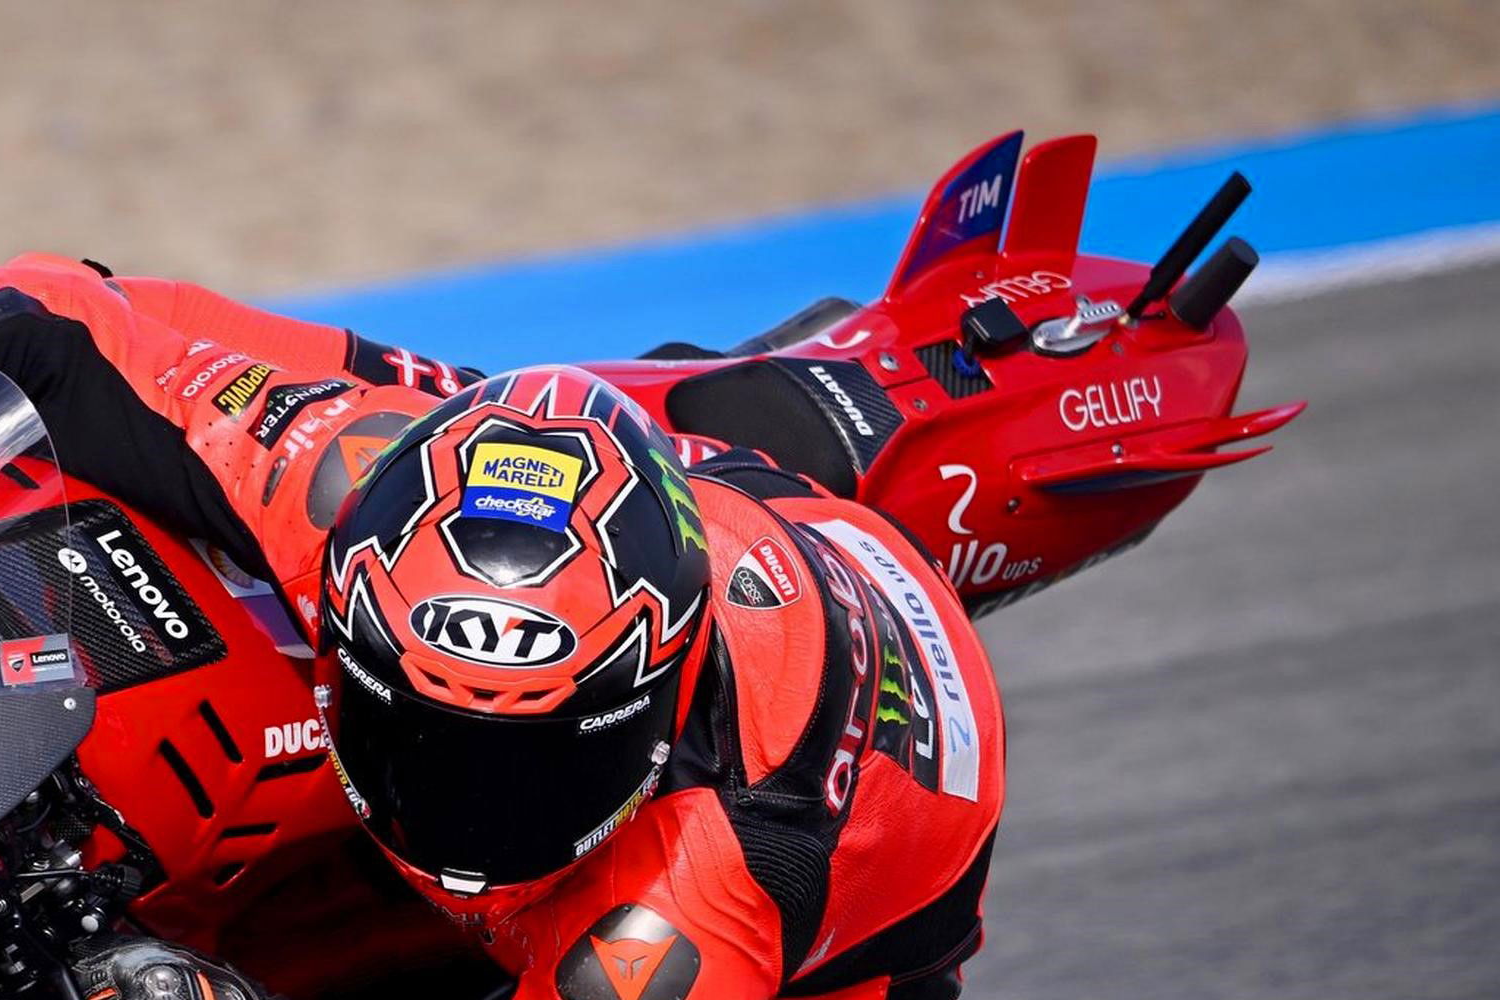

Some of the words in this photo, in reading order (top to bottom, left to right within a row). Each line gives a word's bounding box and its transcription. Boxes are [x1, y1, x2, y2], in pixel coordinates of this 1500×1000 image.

[957, 174, 1002, 224] TIM
[809, 366, 874, 437] DUCATI
[1059, 376, 1162, 432] GELLIFY
[95, 529, 189, 639] Lenovo
[759, 545, 795, 597] DUCATI
[1002, 556, 1043, 582] ups
[79, 575, 147, 653] motorola
[423, 600, 562, 659] KYT
[337, 647, 392, 702] CARRERA
[580, 695, 651, 730] CARRERA
